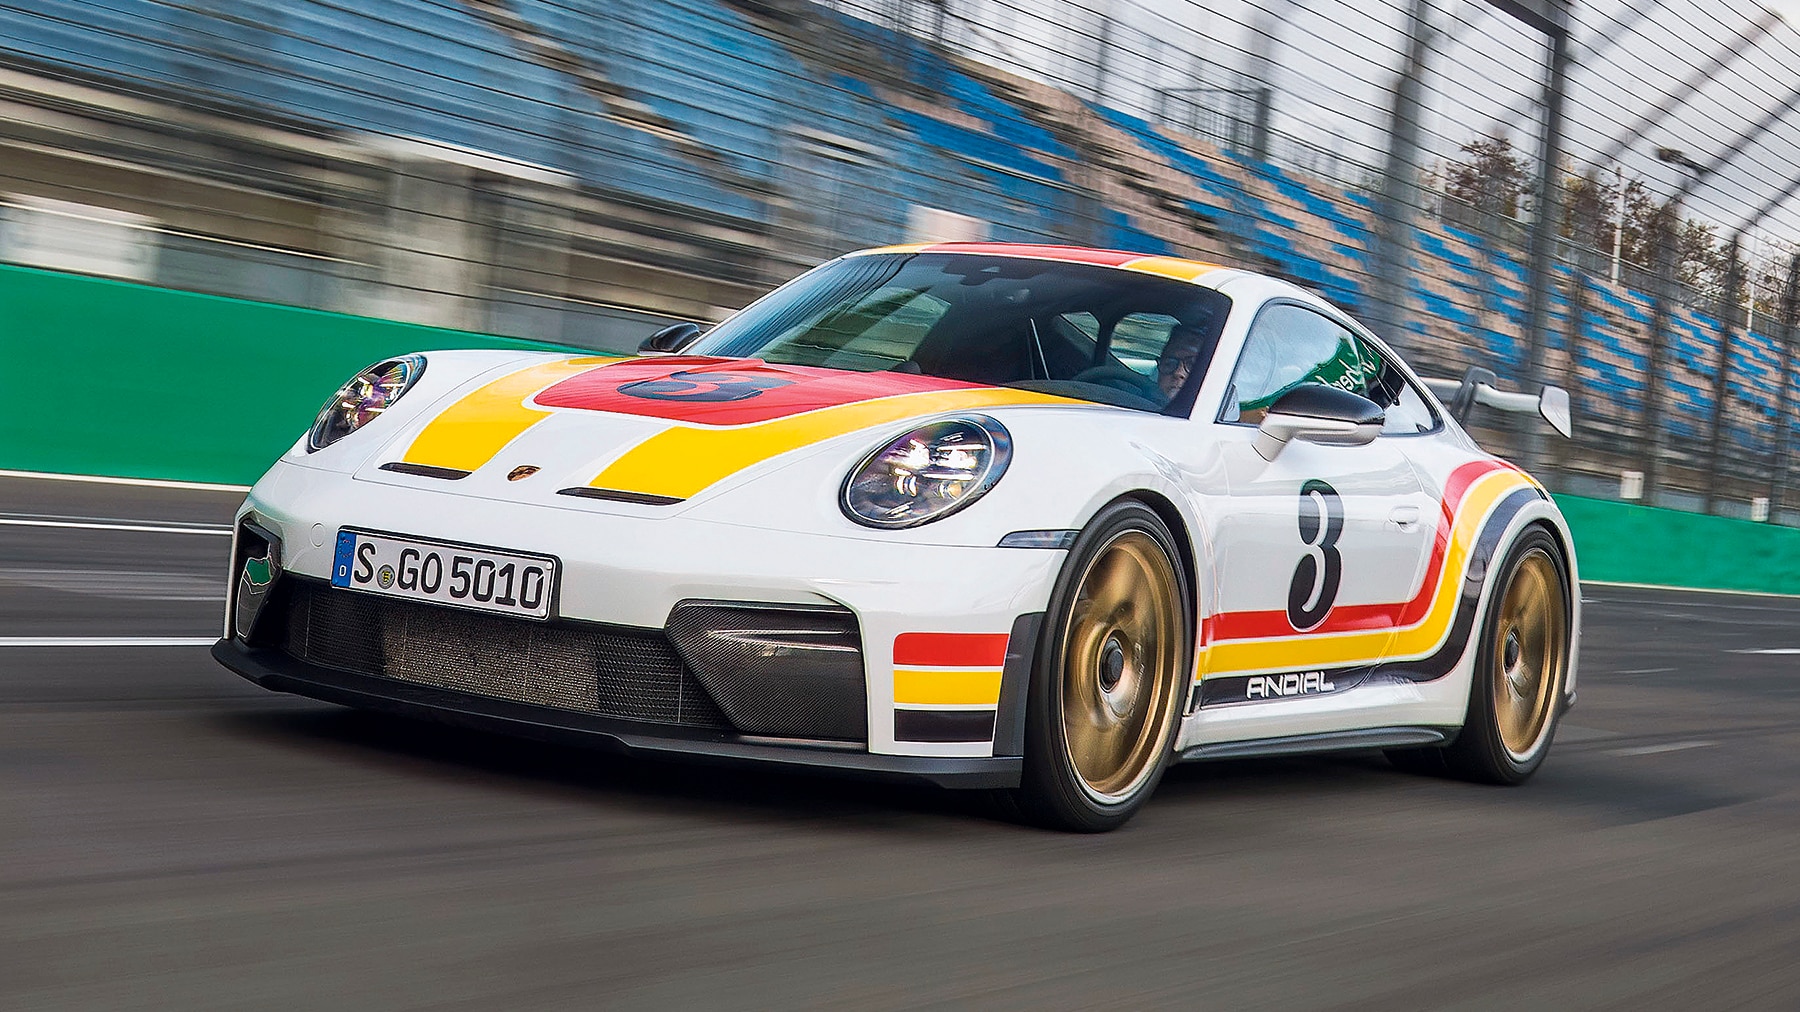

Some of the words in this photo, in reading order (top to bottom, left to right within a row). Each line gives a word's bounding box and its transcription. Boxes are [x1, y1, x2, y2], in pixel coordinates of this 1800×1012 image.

[616, 370, 797, 403] 3
[353, 542, 377, 584] S
[397, 547, 443, 594] GO
[449, 555, 545, 610] 5010
[1287, 478, 1345, 633] 3
[1246, 671, 1336, 699] ANDIAL
